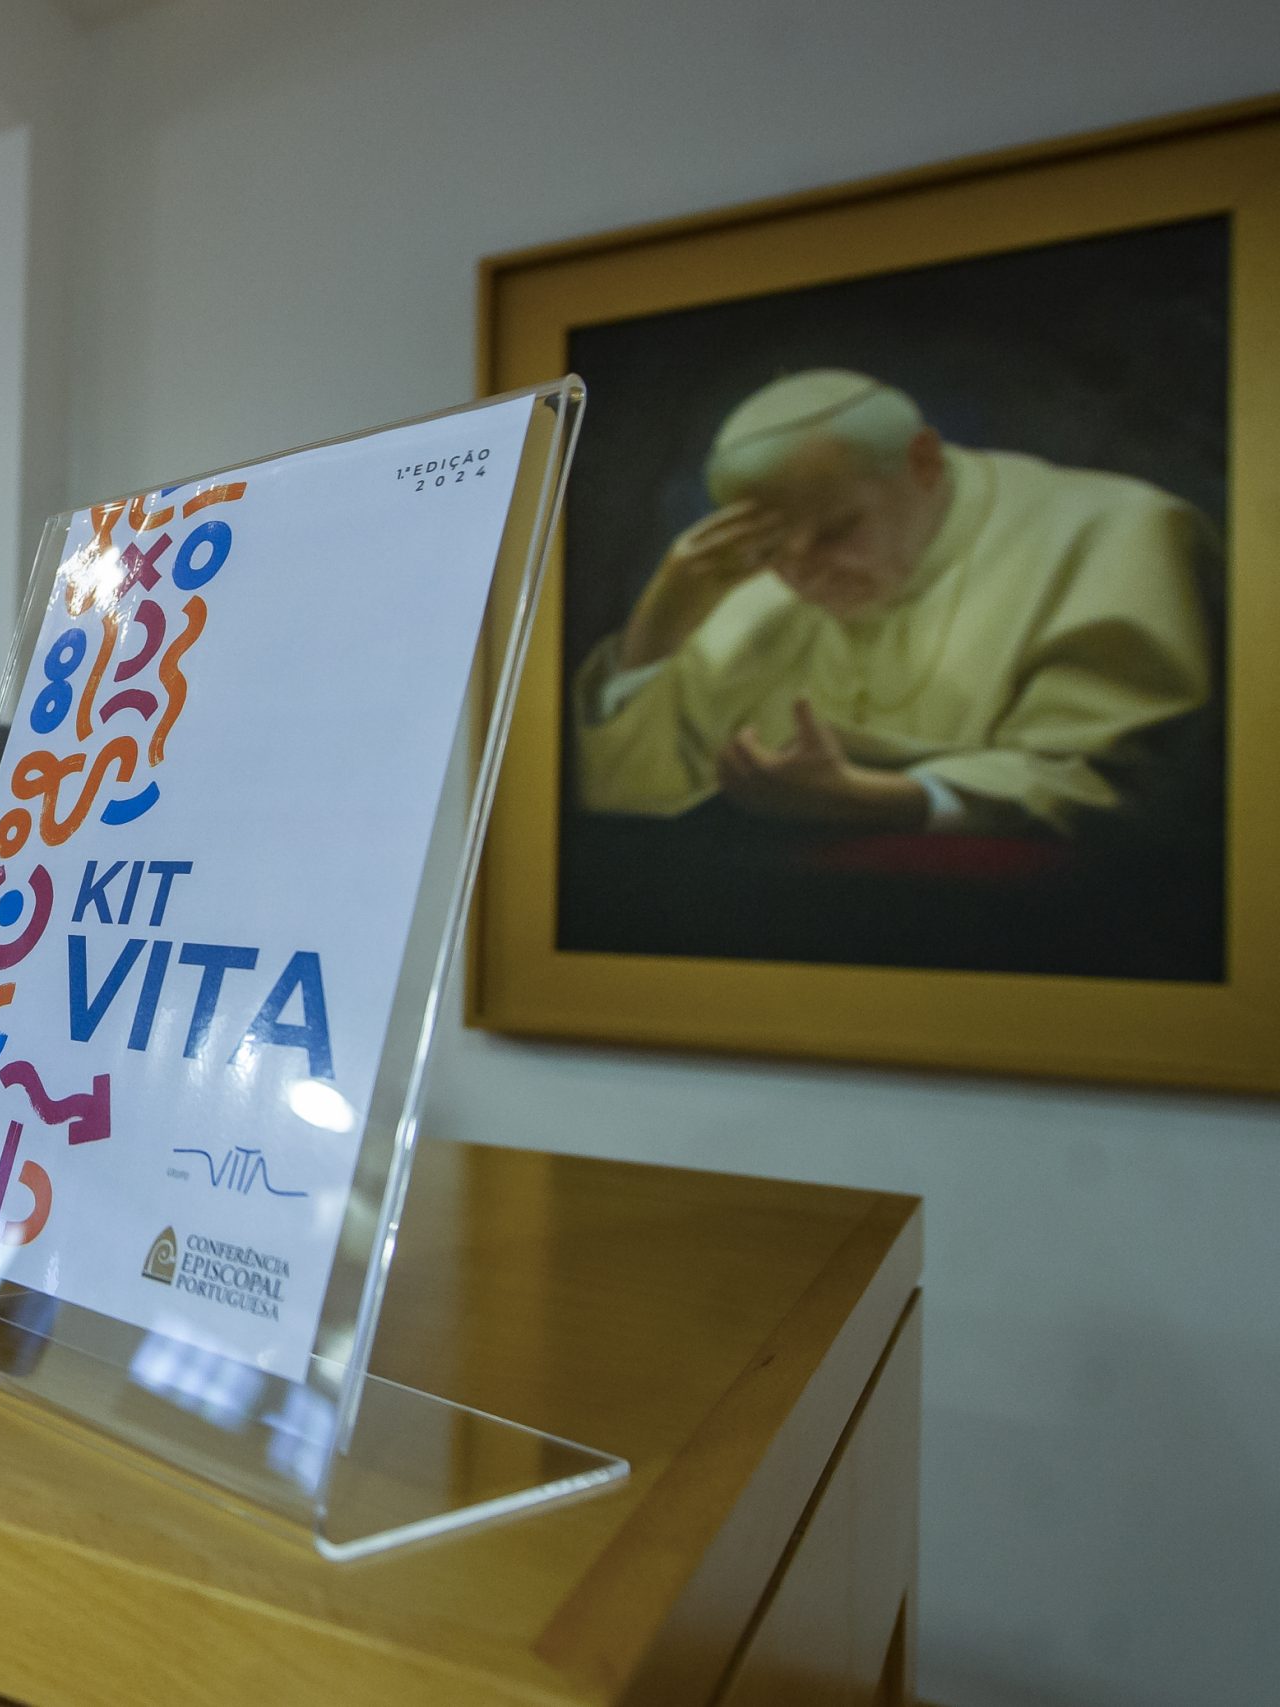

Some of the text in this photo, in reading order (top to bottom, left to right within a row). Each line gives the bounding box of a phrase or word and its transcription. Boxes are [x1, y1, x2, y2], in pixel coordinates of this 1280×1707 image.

[415, 465, 486, 492] 2024
[71, 860, 194, 927] KIT
[67, 934, 336, 1080] VITA
[172, 1146, 310, 1197] VITA
[181, 1251, 284, 1303] EPISCOPAL
[186, 1233, 290, 1279] CONFERÊNCIA
[176, 1271, 280, 1322] PORTUGUESA
